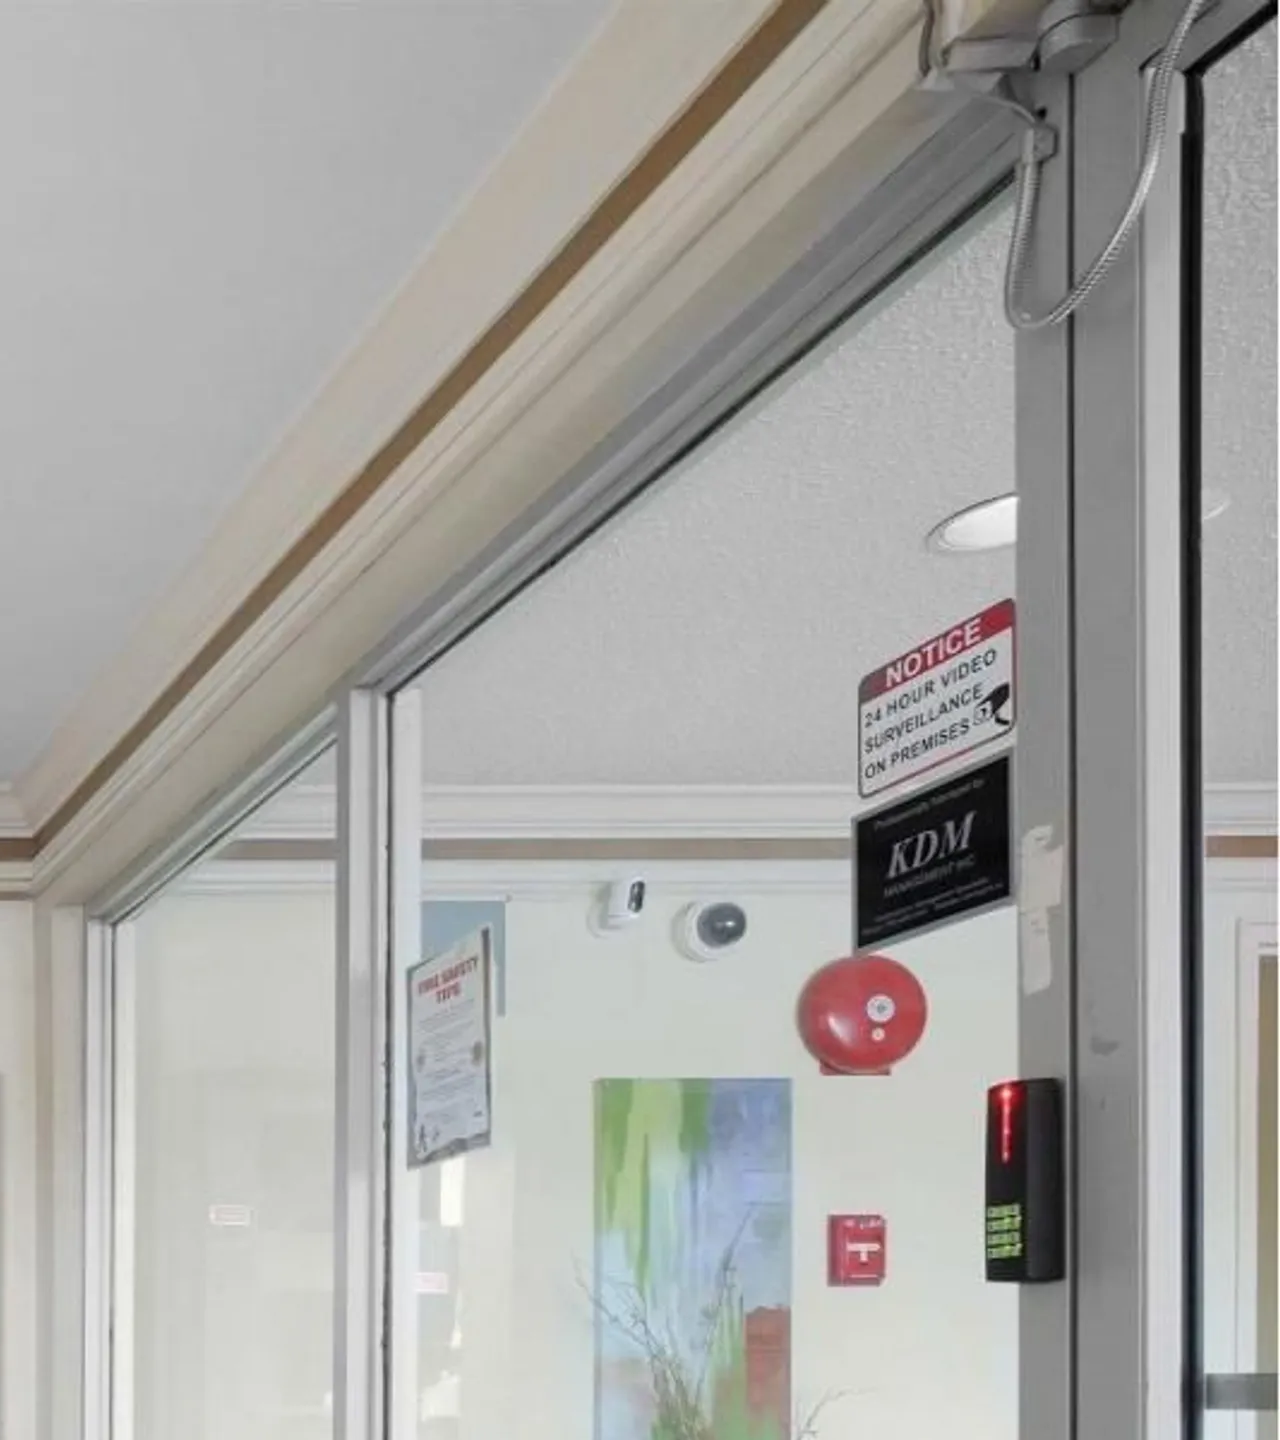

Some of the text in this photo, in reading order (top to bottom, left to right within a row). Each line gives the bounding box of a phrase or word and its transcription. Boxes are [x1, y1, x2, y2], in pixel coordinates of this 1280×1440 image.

[864, 647, 997, 729] 24 HOUR VIDEO
[885, 617, 982, 688] NOTICE
[864, 682, 984, 754] SURVEILLANCE
[864, 717, 971, 779] ON PREMISES
[886, 809, 978, 879] KDM
